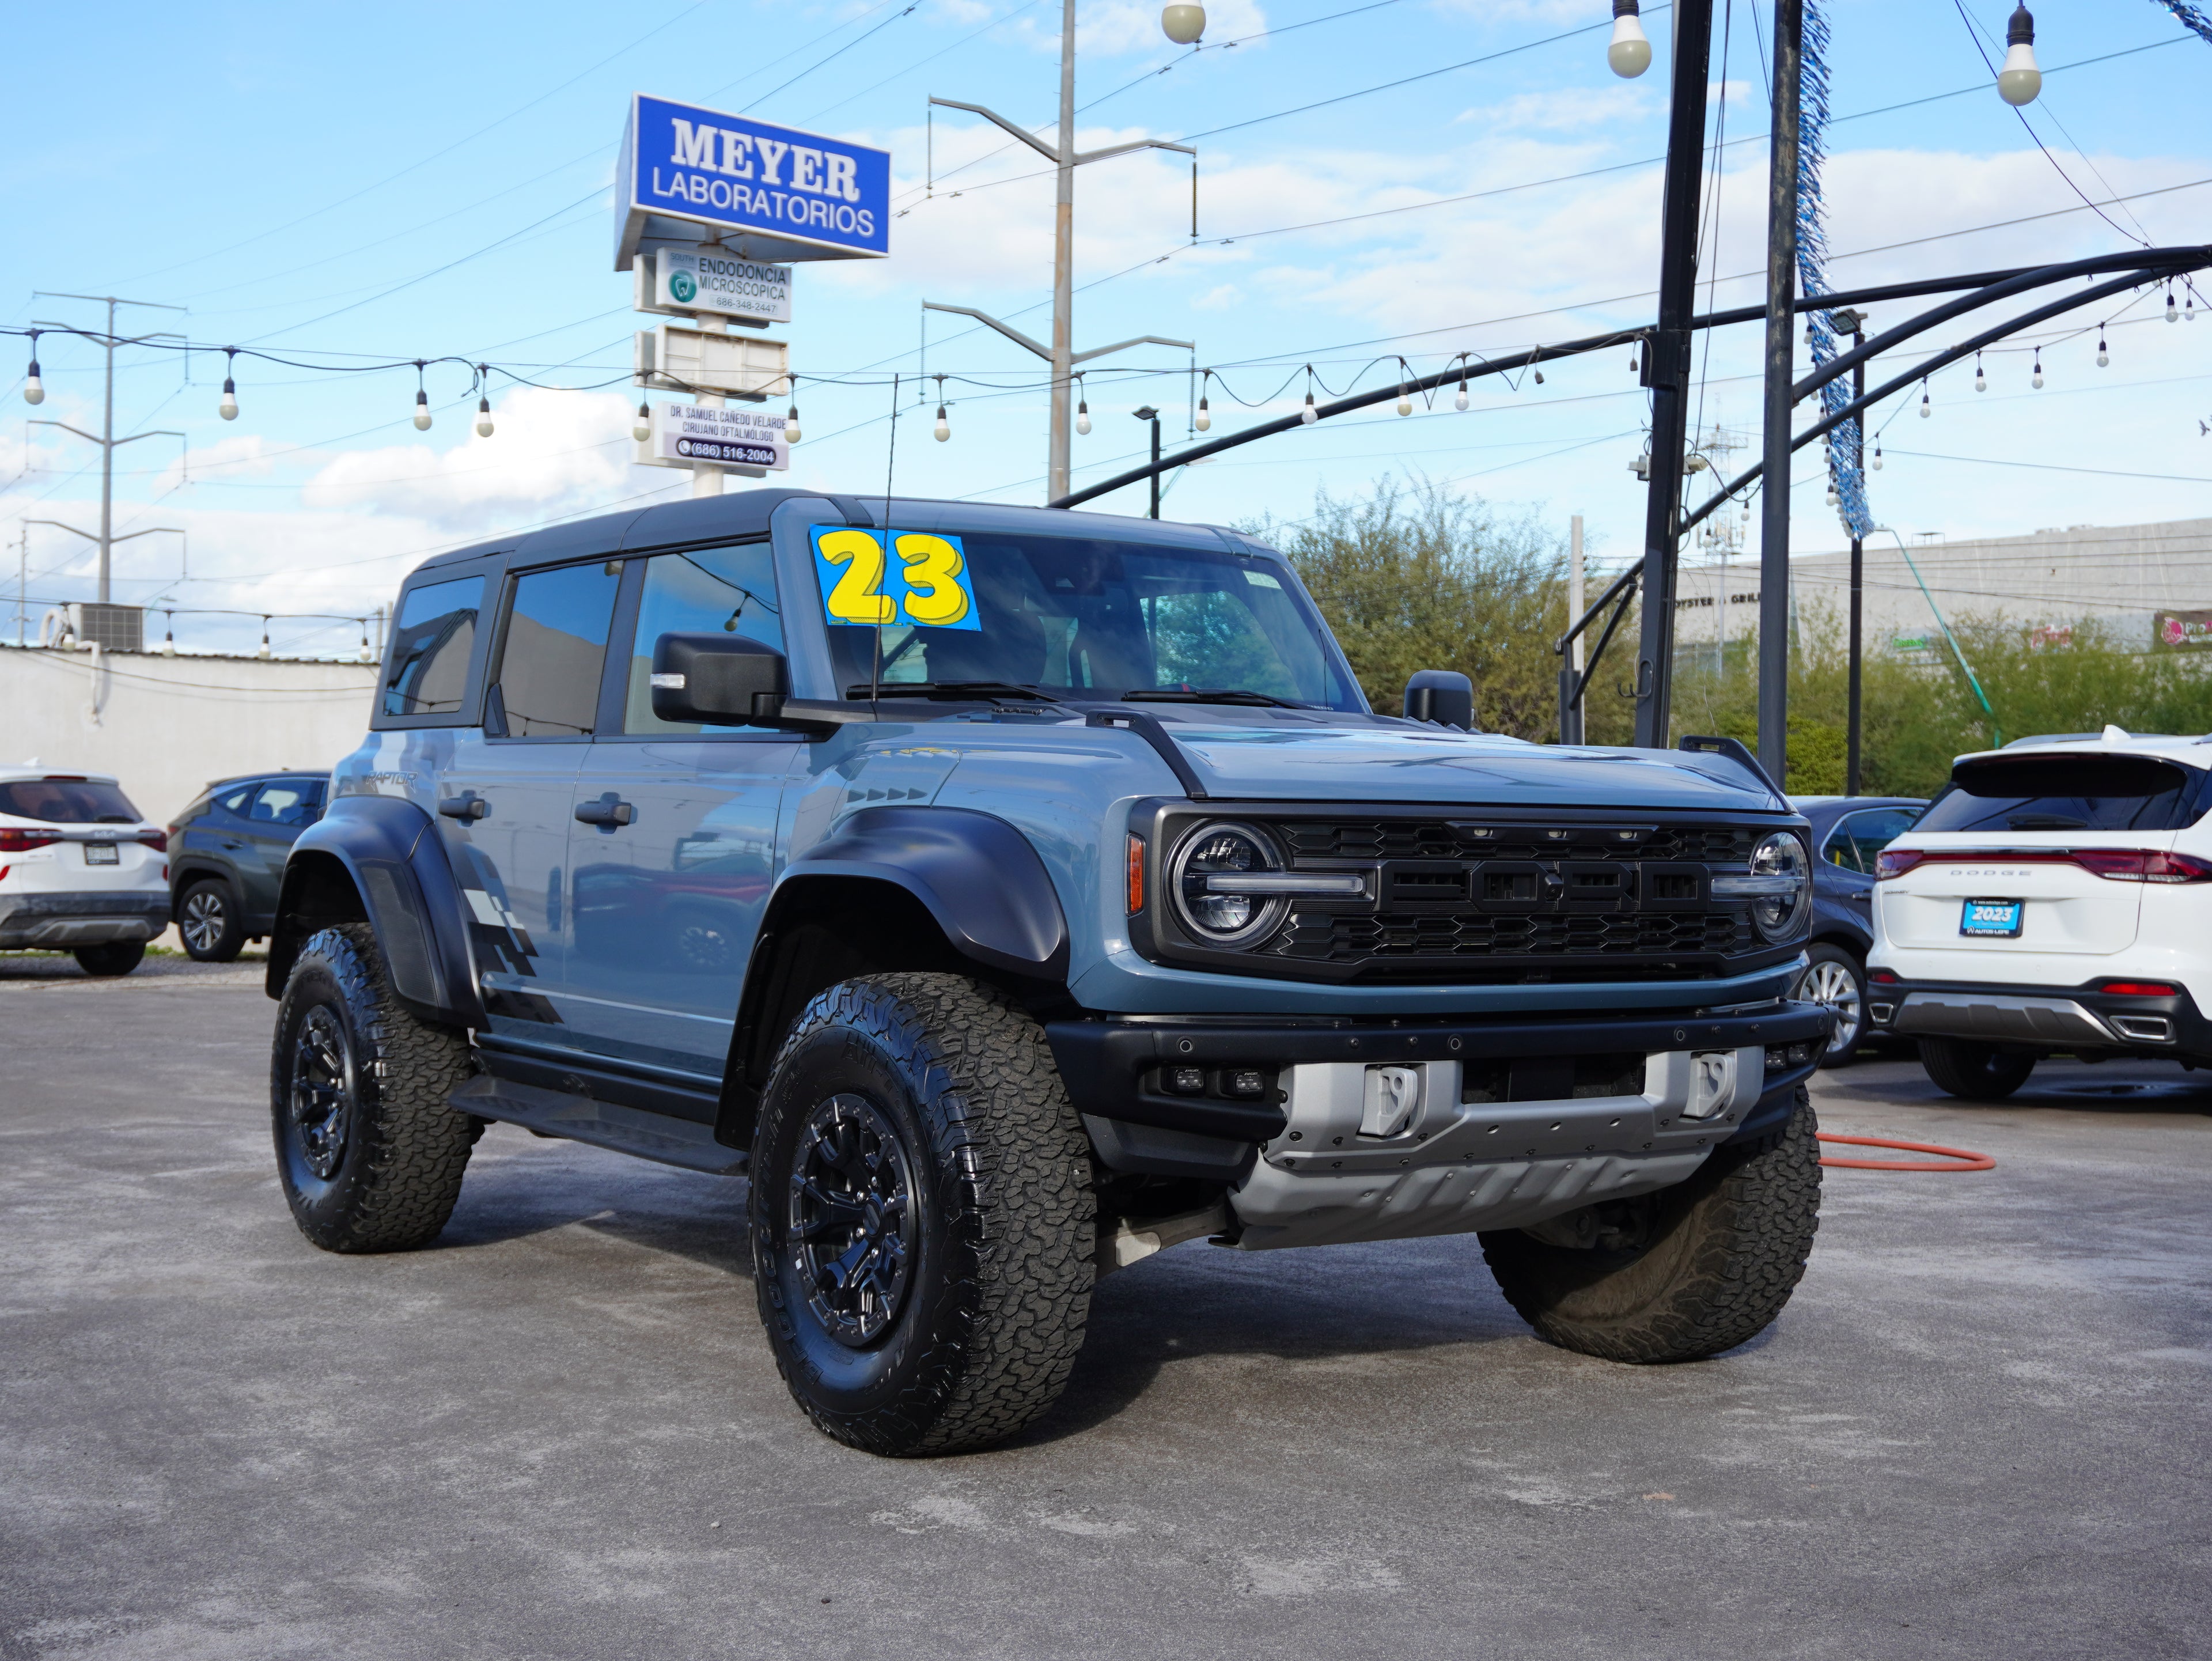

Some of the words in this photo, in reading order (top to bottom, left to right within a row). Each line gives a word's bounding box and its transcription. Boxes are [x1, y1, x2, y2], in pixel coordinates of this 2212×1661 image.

[671, 118, 861, 203] MEYER
[653, 167, 875, 238] LABORATORIOS
[671, 252, 694, 262] SOUTH
[699, 257, 786, 285] ENDODONCIA
[699, 275, 785, 301] MICROSCOPICA
[716, 297, 777, 313] 686-348-2447
[670, 405, 683, 418] DR.
[685, 407, 718, 422] SAMUEL
[719, 409, 751, 426] CAÑEDO
[752, 415, 787, 430] VELARDE
[682, 421, 719, 436] CIRUJANO
[721, 425, 774, 442] OFTALMÓLOGO
[691, 442, 720, 458] (686)
[723, 446, 775, 463] 516-2004
[817, 530, 969, 626] 23
[366, 770, 418, 793] RAPTOR
[1375, 859, 1710, 913] FORD
[1971, 906, 2014, 922] 2023
